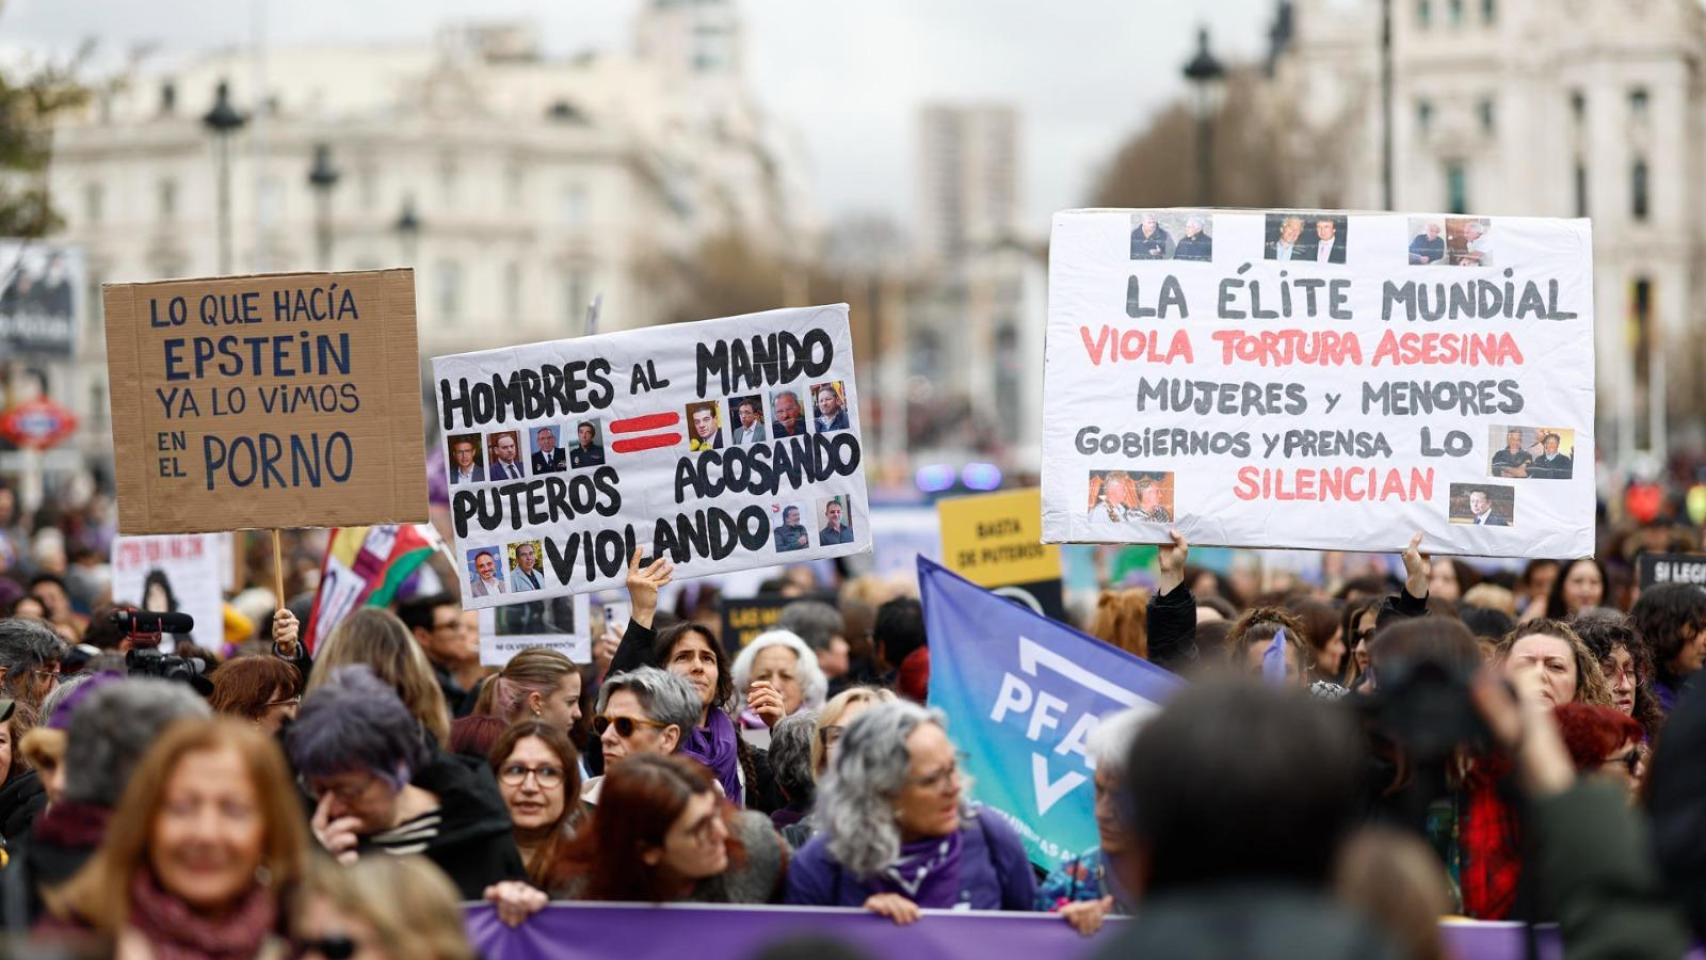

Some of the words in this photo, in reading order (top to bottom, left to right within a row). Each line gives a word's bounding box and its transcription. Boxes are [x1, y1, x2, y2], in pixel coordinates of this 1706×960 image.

[150, 297, 188, 328] LO
[199, 292, 263, 327] QUE
[273, 283, 359, 321] HACÍA
[1127, 275, 1188, 319] LA
[1080, 326, 1194, 366] VIOLA
[1212, 329, 1363, 367] TORTURA
[1372, 330, 1524, 367] ASESINA
[440, 357, 615, 430] HOMBRES
[630, 359, 670, 395] AL
[696, 328, 835, 397] MANDO
[1137, 377, 1307, 416] MUJERES
[1362, 379, 1524, 416] MENORES
[156, 387, 200, 419] YA
[211, 386, 246, 416] LO
[158, 431, 187, 451] EN
[159, 456, 187, 477] EL
[203, 431, 353, 490] PORNO
[1283, 428, 1393, 459] PRENSA
[1420, 427, 1473, 457] LO
[453, 465, 622, 538] PUTEROS
[675, 432, 860, 503] ACOSANDO
[1233, 466, 1434, 502] SILENCIAN
[545, 505, 770, 586] VIOLANDO
[1655, 561, 1670, 582] SI
